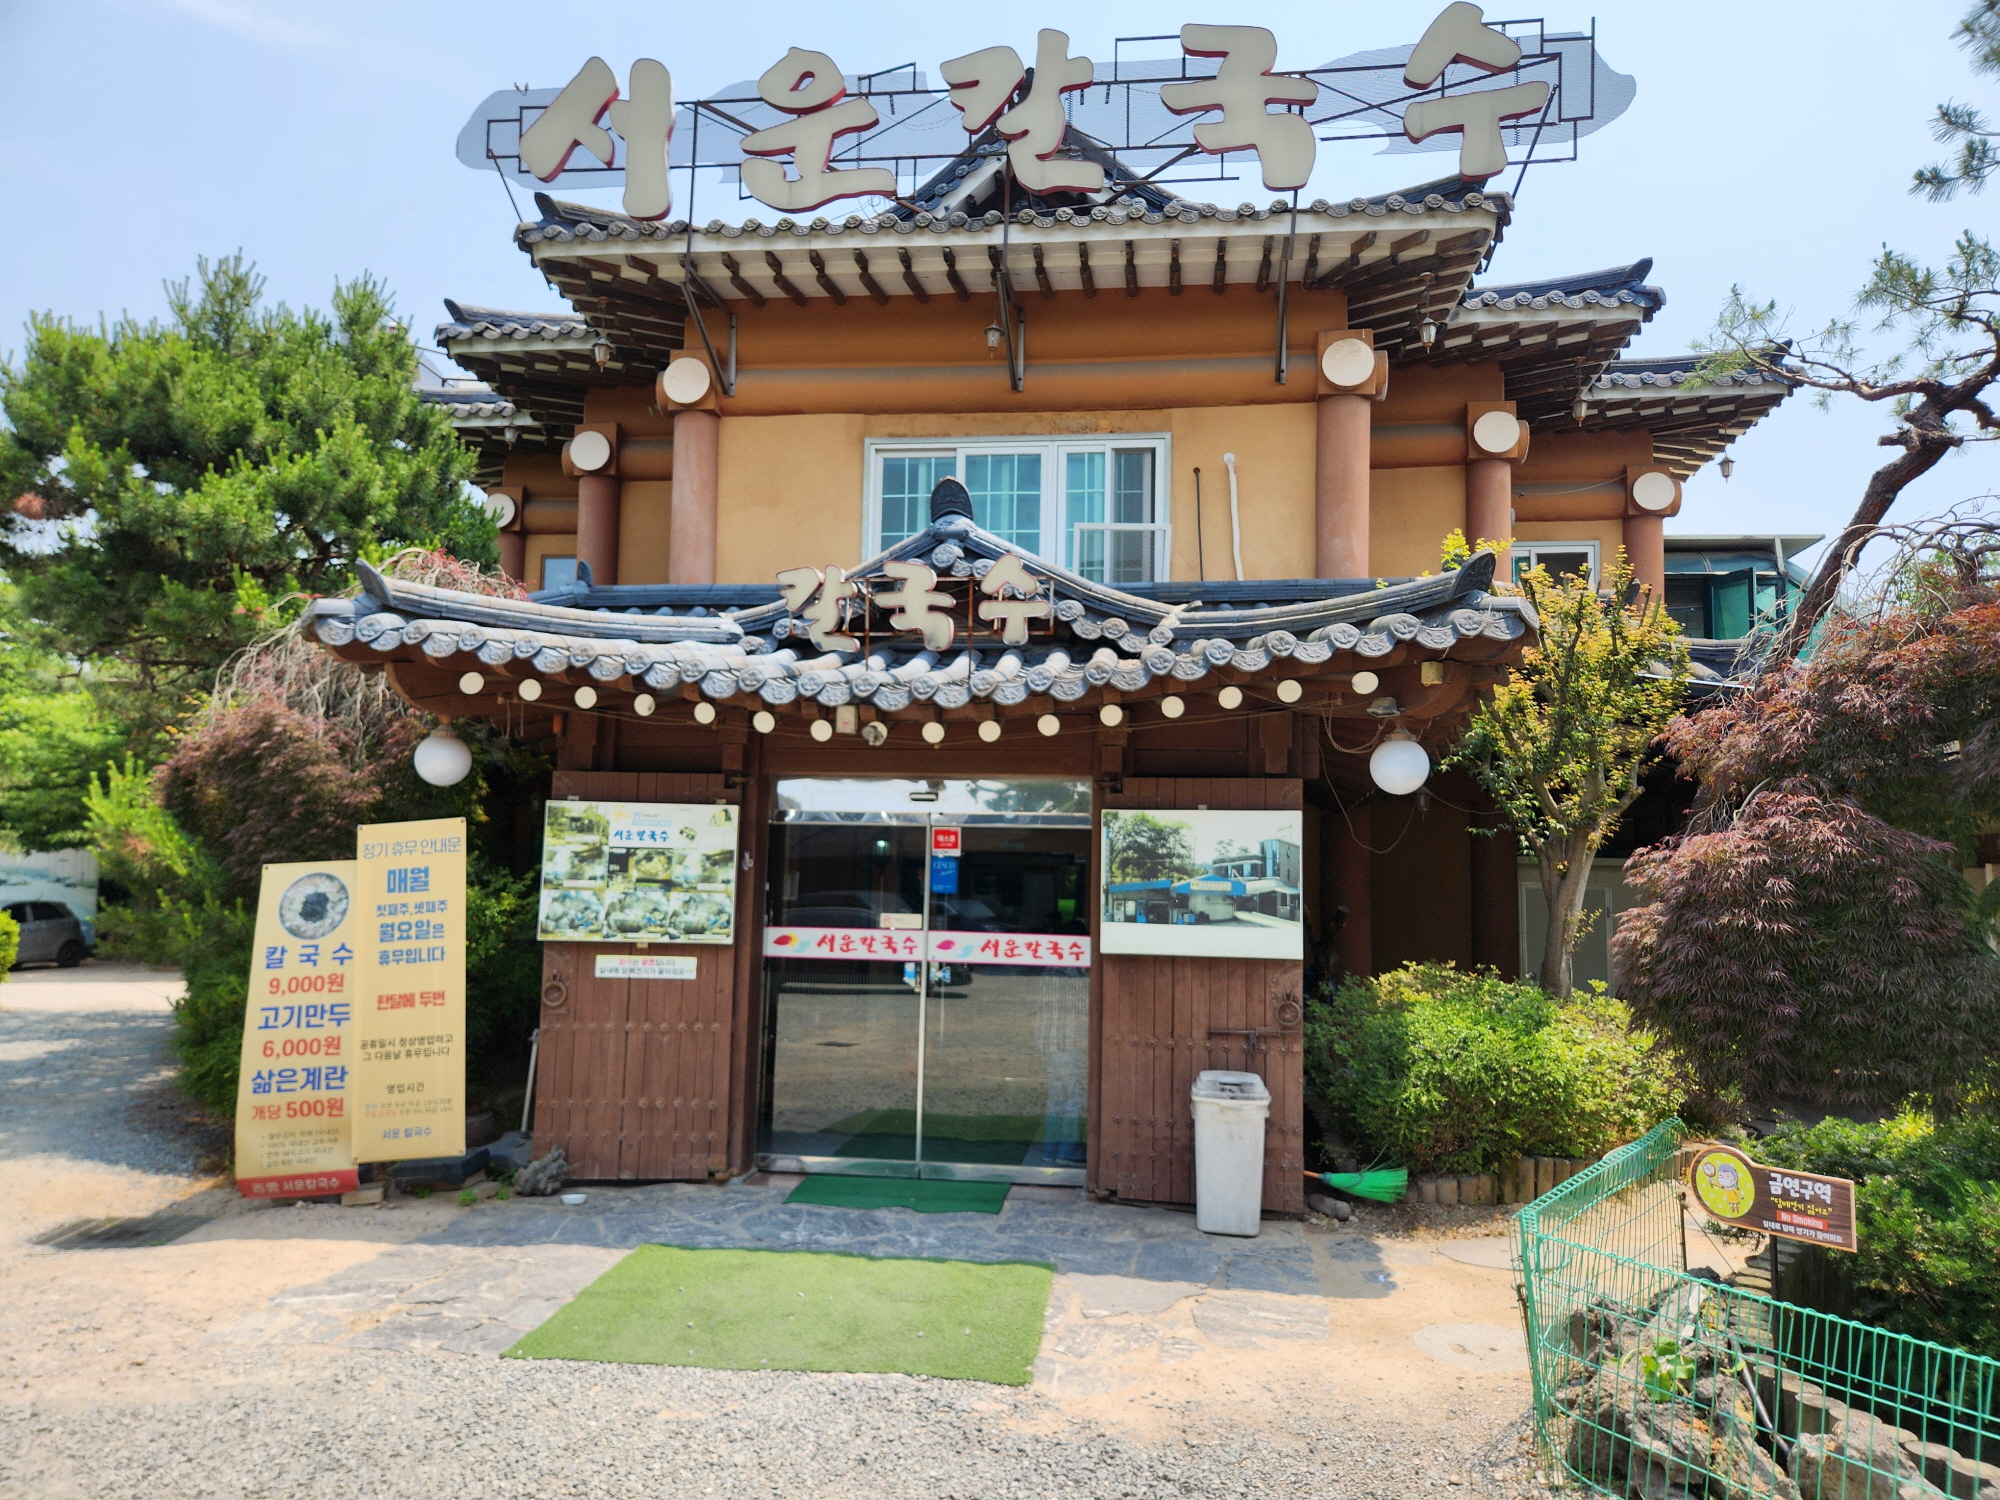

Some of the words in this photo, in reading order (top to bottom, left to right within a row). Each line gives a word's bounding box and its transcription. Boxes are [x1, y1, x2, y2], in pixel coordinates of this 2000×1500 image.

[519, 1, 1549, 221] 서운칼국수
[776, 553, 1051, 652] 칼국수
[613, 829, 670, 842] 서운칼국수
[363, 843, 388, 859] 정기
[392, 840, 417, 856] 휴무
[420, 837, 461, 855] 안내문
[387, 866, 429, 893] 매월
[379, 919, 445, 943] 월요일은
[379, 946, 446, 965] 휴무입니다
[816, 933, 919, 955] 서운칼국수
[979, 937, 1086, 961] 서운칼국수
[268, 972, 345, 997] 9,000원
[419, 991, 446, 1008] 두번
[257, 1002, 351, 1030] 고기만두
[262, 1034, 342, 1060] 6,000원
[404, 1046, 450, 1059] 휴무입니다
[251, 1066, 349, 1095] 삶은계란
[387, 1082, 425, 1094] 영업시간
[252, 1104, 282, 1121] 개당
[286, 1097, 345, 1118] 500원
[1768, 1172, 1832, 1205] 금연구역
[1781, 1212, 1791, 1222] No
[1793, 1213, 1823, 1230] Smoking
